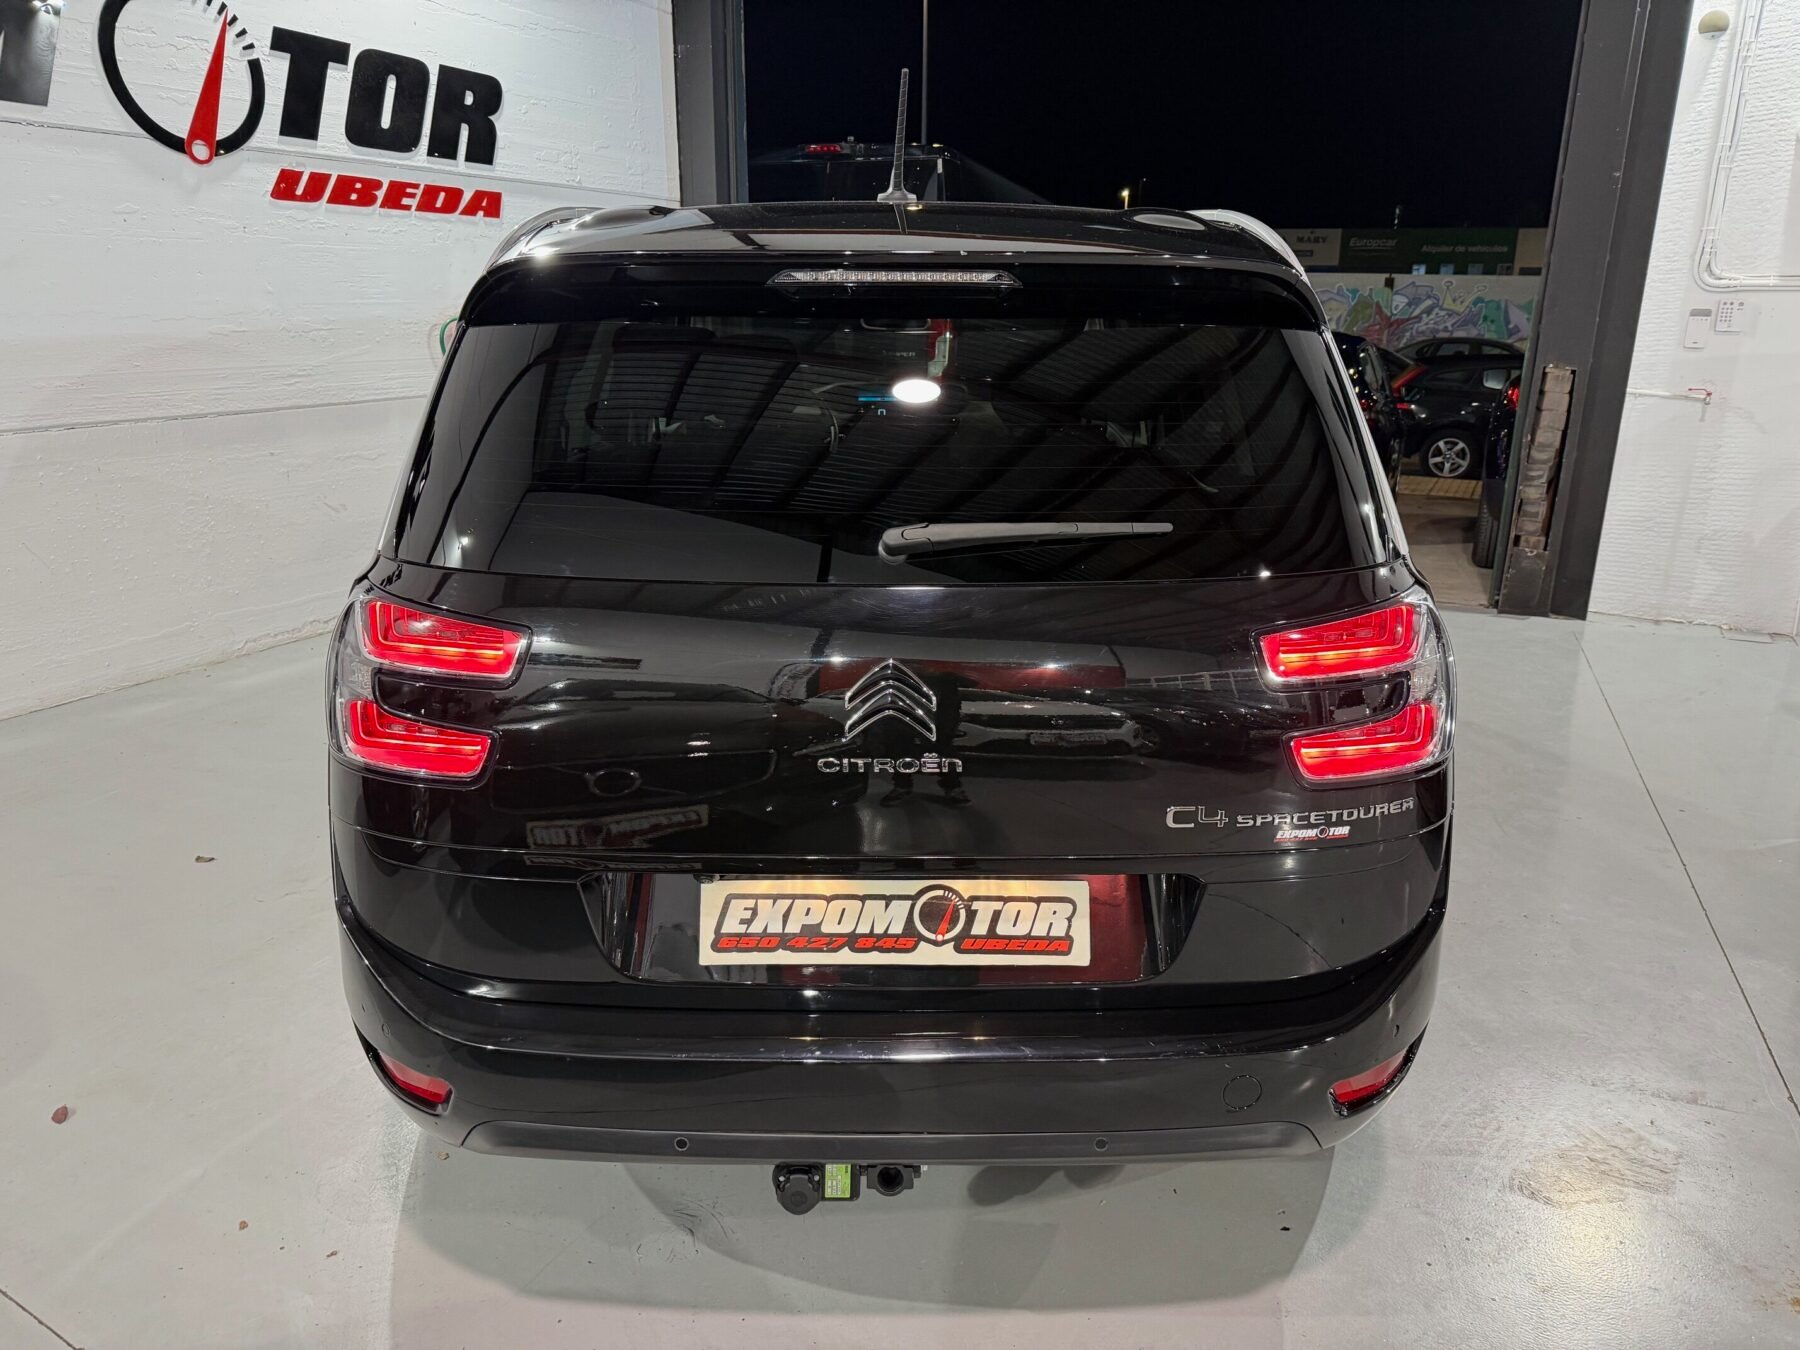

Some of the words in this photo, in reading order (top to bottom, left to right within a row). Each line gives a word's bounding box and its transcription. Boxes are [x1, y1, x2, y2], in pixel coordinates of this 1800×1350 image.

[270, 168, 503, 219] UBEDA
[1349, 237, 1398, 249] Europcar
[1166, 806, 1229, 828] C4
[1236, 797, 1415, 827] SPACETOURER
[716, 936, 782, 949] 650
[786, 936, 848, 949] 427
[853, 936, 919, 949] 845
[960, 938, 1073, 952] UBEDA
